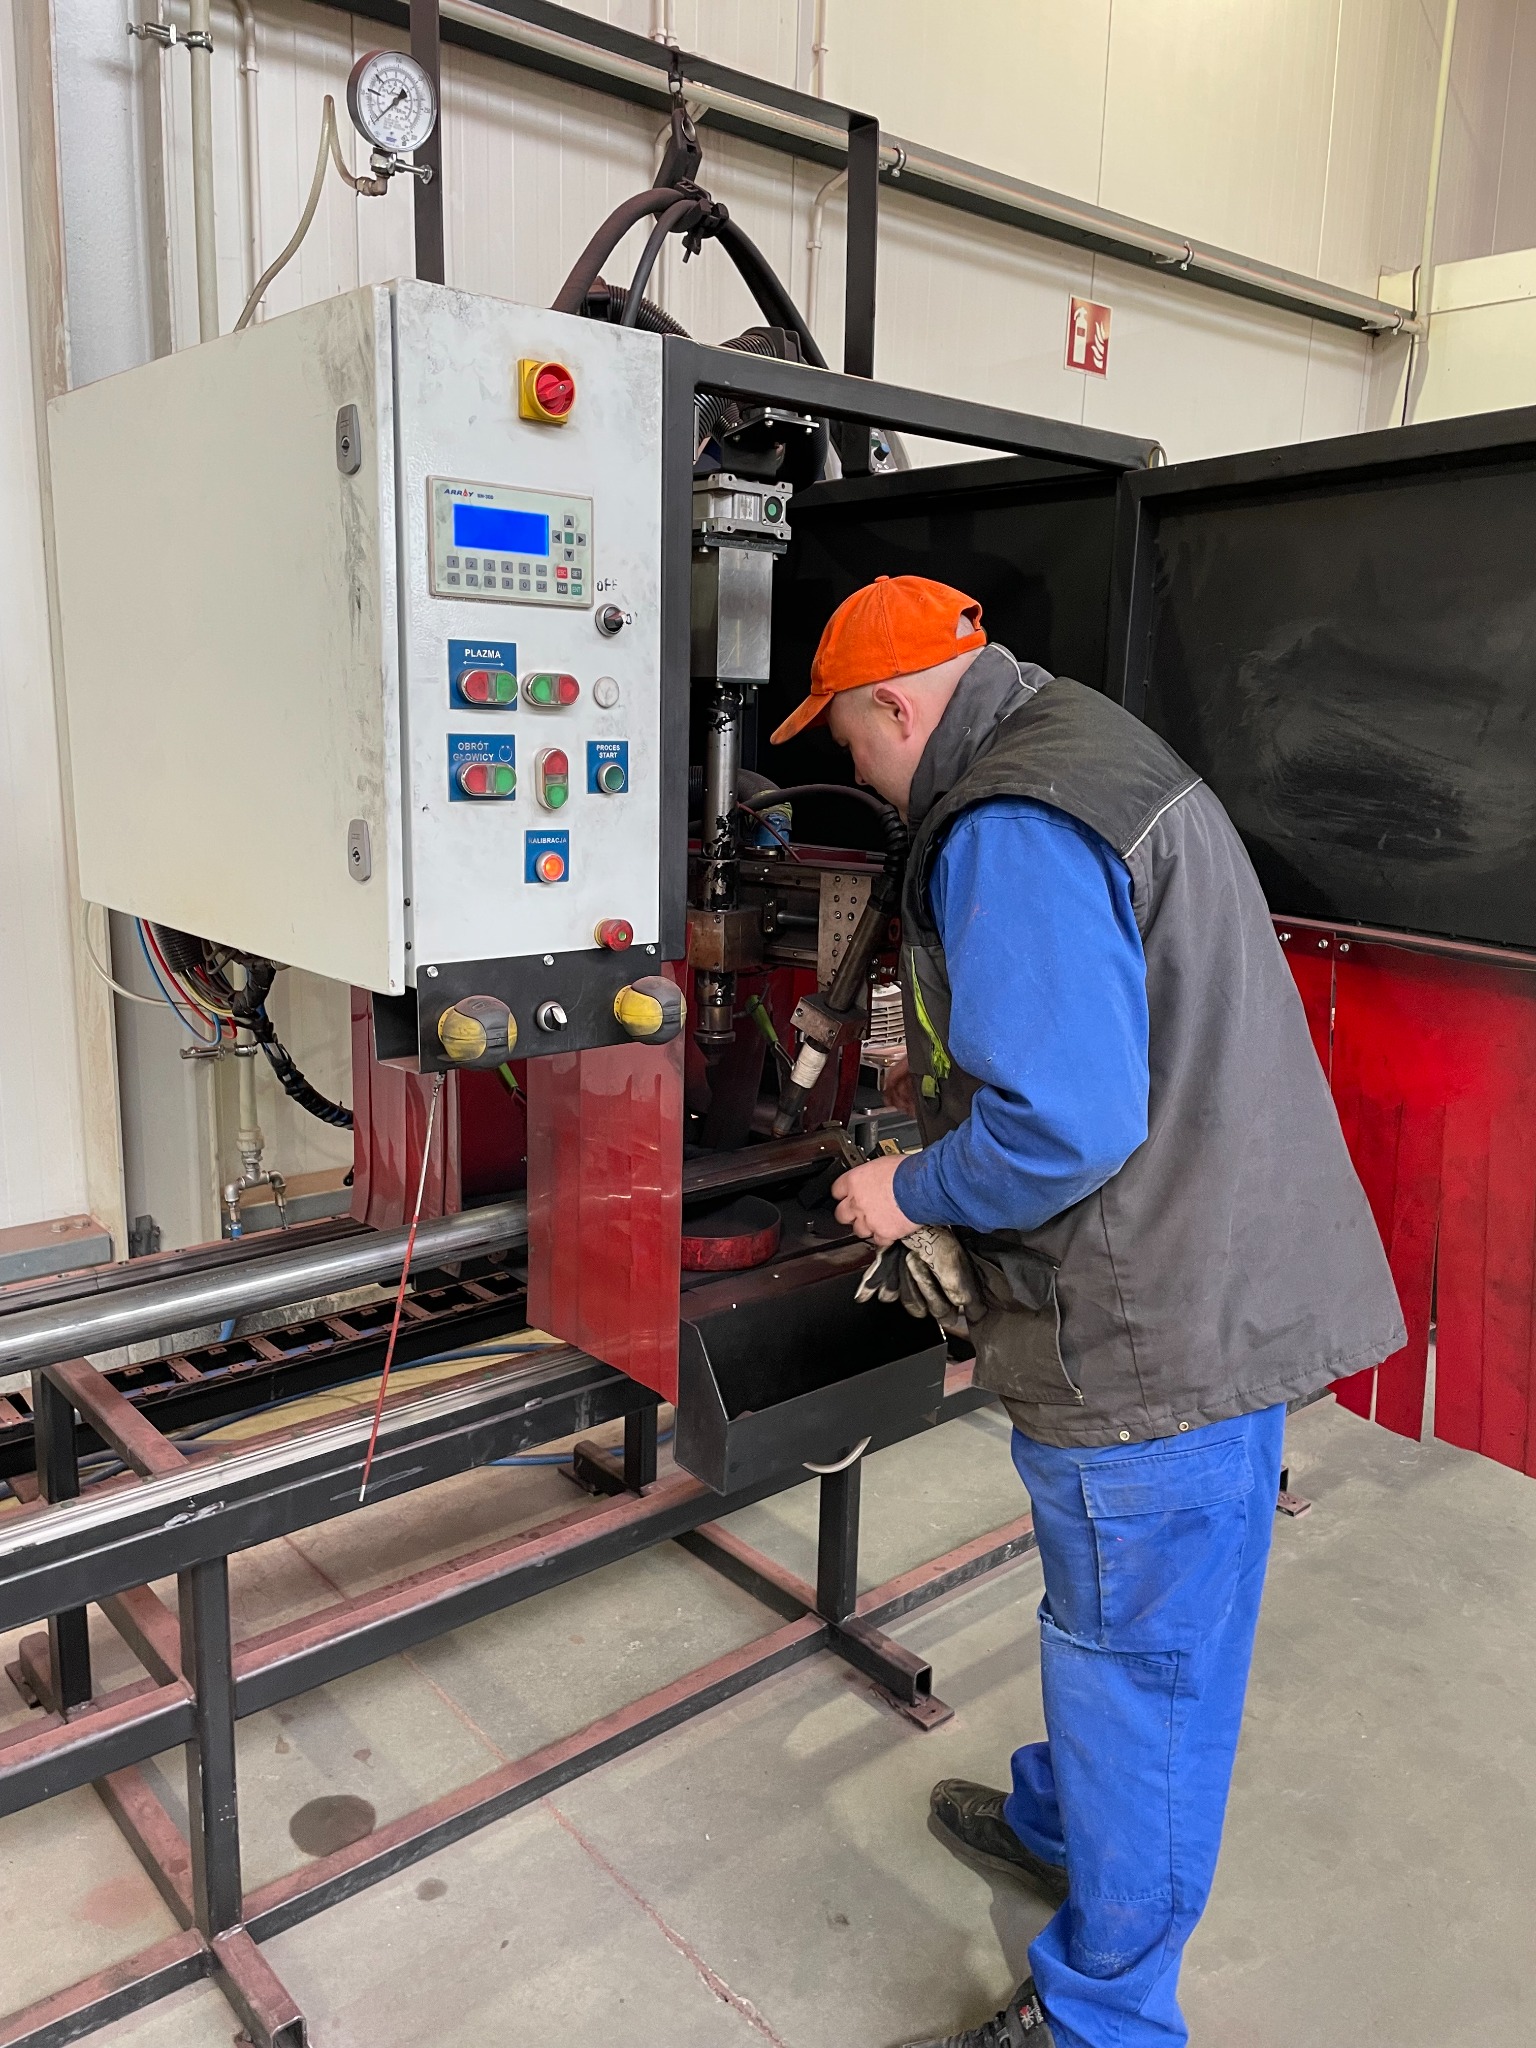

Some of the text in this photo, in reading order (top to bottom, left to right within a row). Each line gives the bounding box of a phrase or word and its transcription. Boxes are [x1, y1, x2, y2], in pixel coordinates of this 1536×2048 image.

[444, 488, 474, 497] ARRAY
[464, 648, 501, 659] PLAZMA
[457, 740, 489, 751] OBRÓT
[596, 744, 621, 752] PROCES
[598, 751, 618, 759] START
